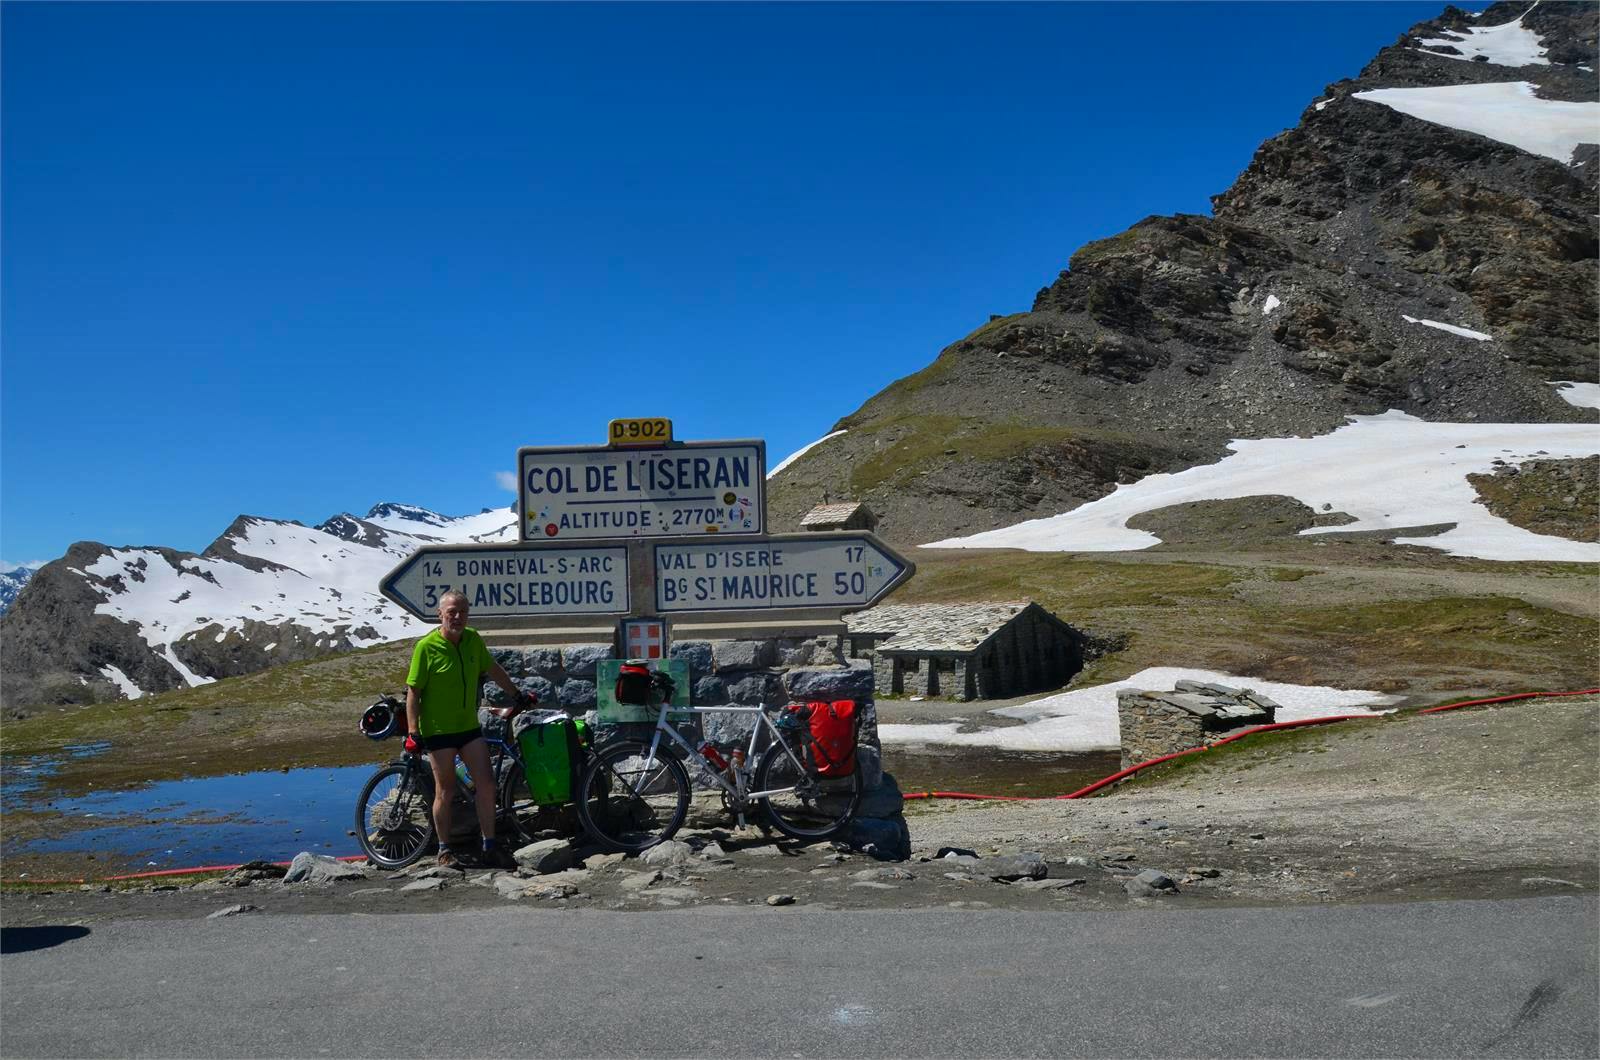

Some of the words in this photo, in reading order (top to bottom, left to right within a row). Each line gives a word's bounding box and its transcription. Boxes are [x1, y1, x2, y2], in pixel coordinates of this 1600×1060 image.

[528, 466, 578, 494] COL
[586, 465, 618, 493] DE
[626, 456, 749, 491] L'ISERAN
[559, 510, 651, 529] ALTITUDE
[423, 561, 443, 577] 14
[660, 552, 697, 570] VAL
[706, 550, 783, 569] D'ISERE
[845, 547, 864, 563] 17
[722, 573, 818, 600] MAURICE
[834, 571, 865, 596] 50
